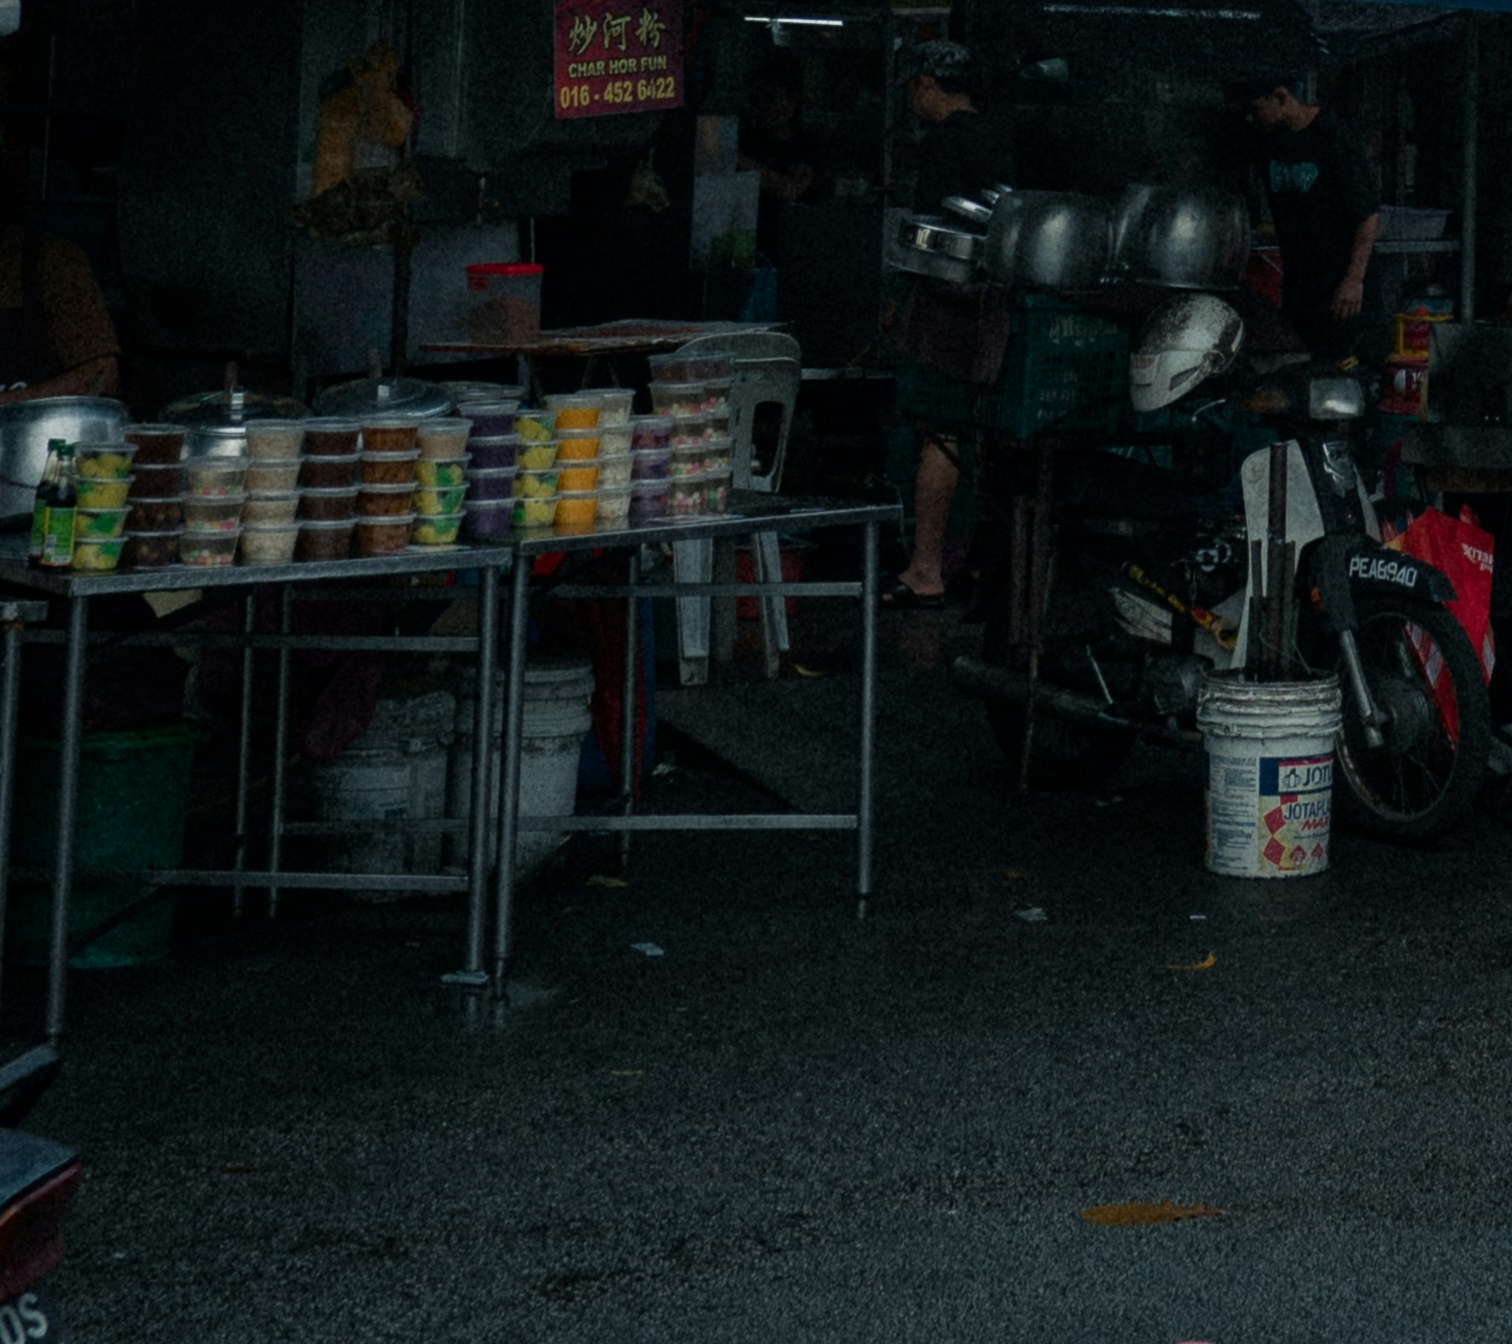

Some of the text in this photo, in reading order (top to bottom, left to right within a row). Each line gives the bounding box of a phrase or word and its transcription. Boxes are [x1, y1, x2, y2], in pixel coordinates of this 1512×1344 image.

[568, 7, 667, 56] 炒河粉
[569, 54, 668, 79] CHAR HOR FUN
[560, 84, 590, 109] 016
[604, 80, 633, 103] 452
